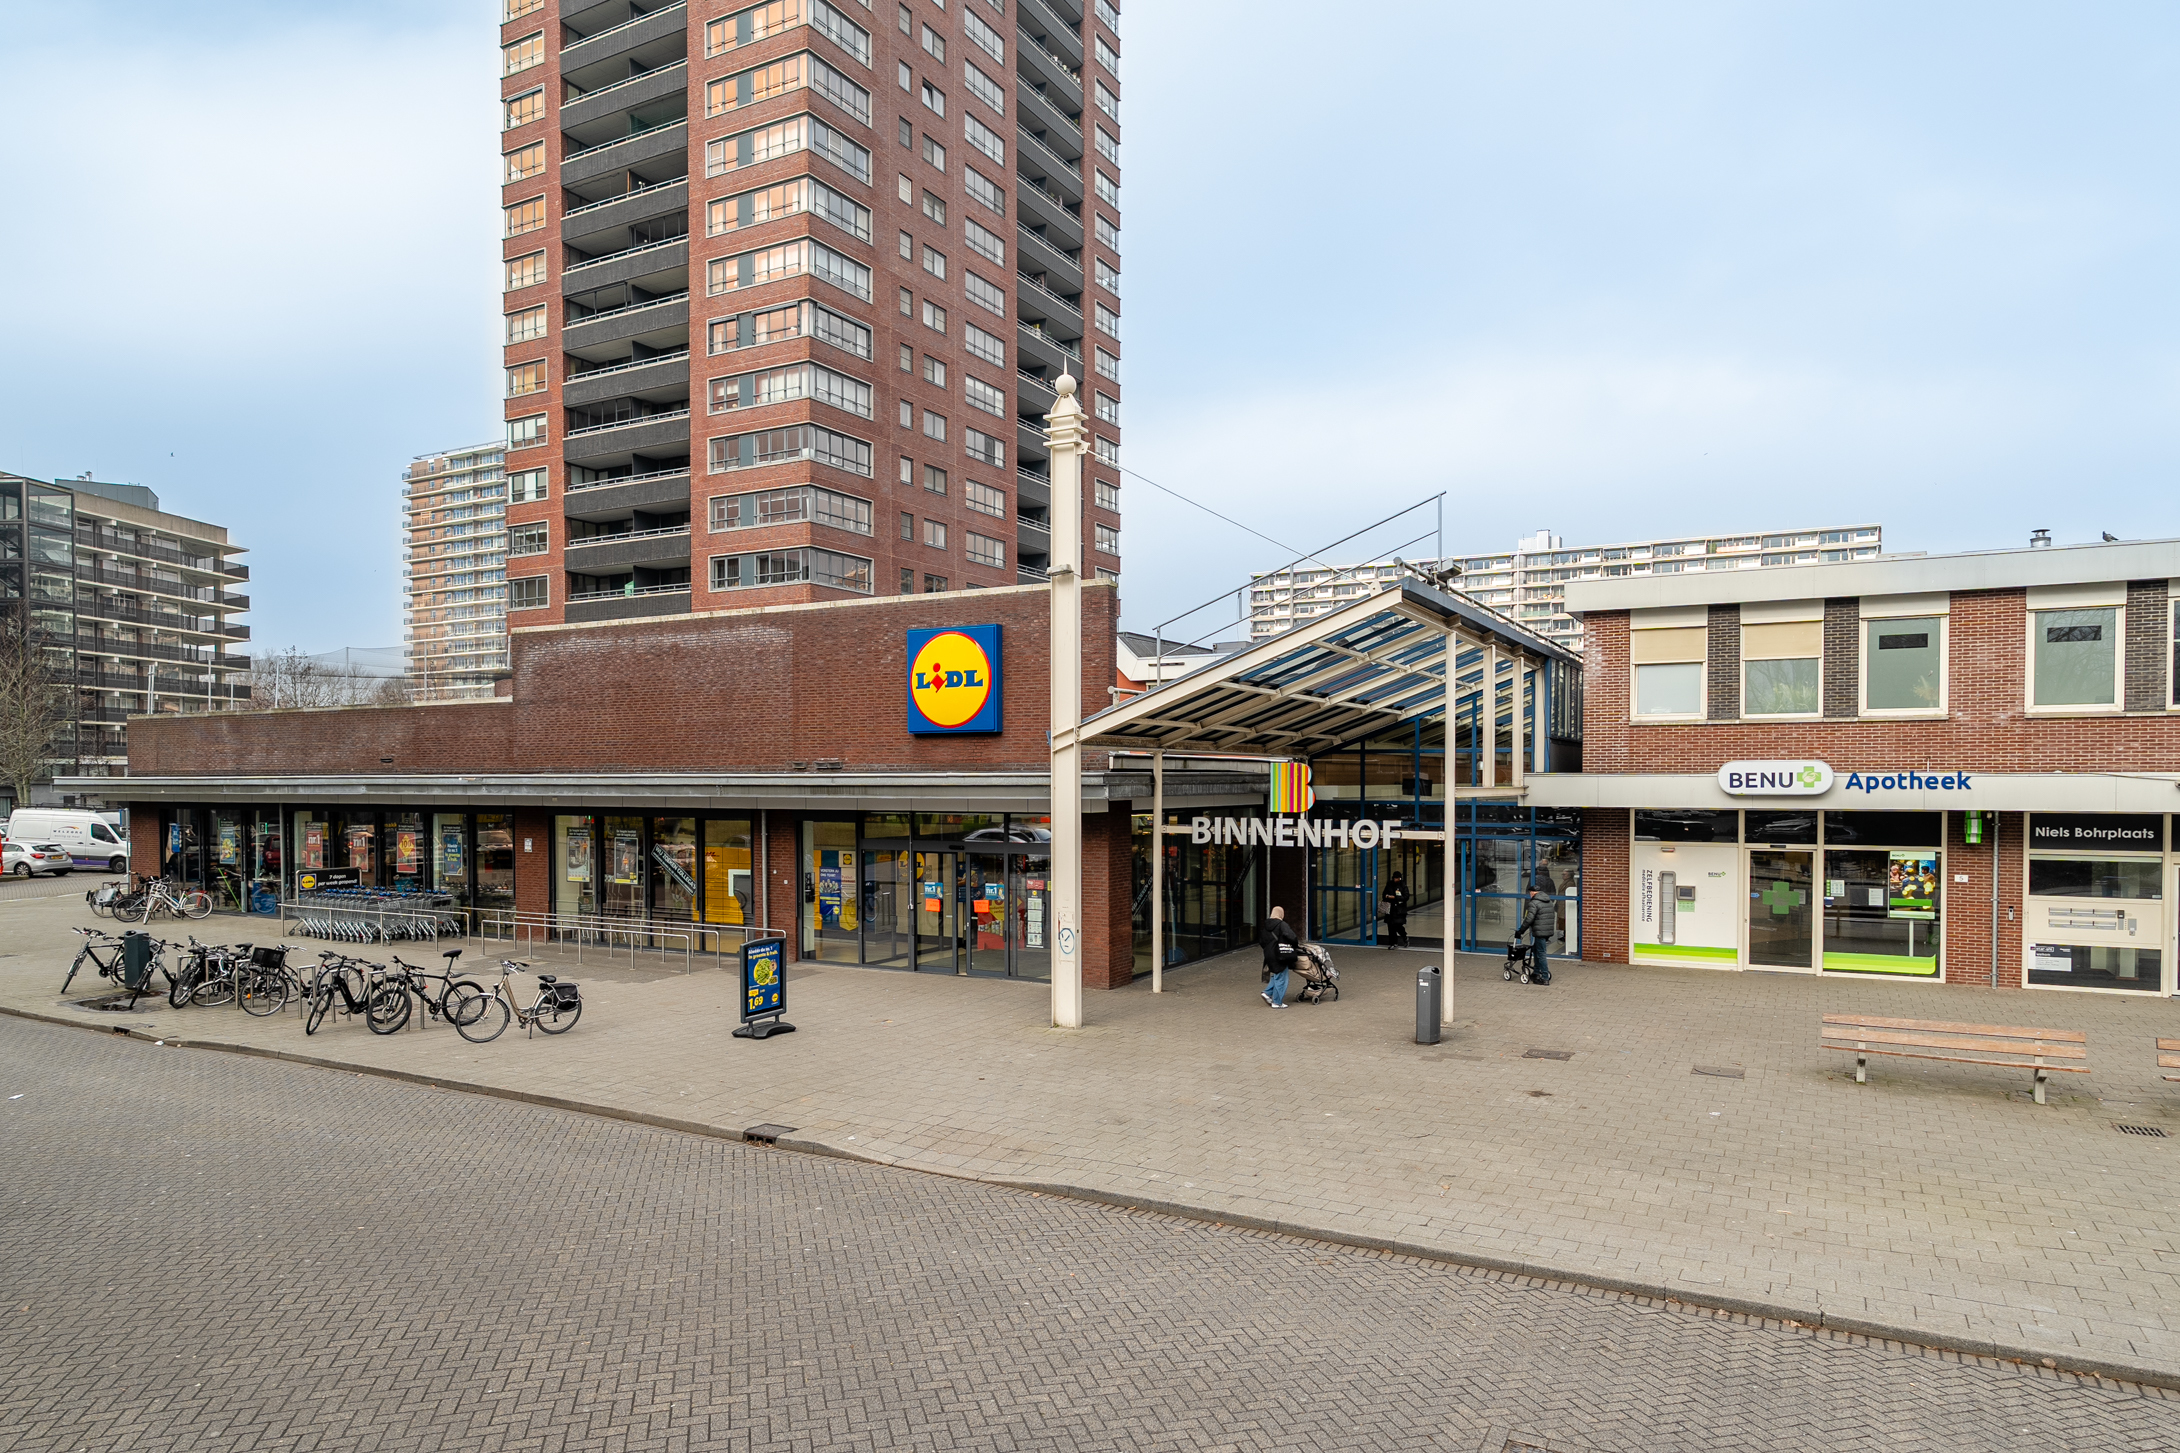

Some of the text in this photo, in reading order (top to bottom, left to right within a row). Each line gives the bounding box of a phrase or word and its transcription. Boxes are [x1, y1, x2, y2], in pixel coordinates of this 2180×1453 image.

[916, 662, 983, 693] LIDL
[1729, 771, 1972, 794] BENU Apotheek
[1191, 816, 1402, 850] BINNENHOF
[2035, 827, 2155, 840] Niels Bohrplaats
[748, 996, 764, 1010] 1.69
